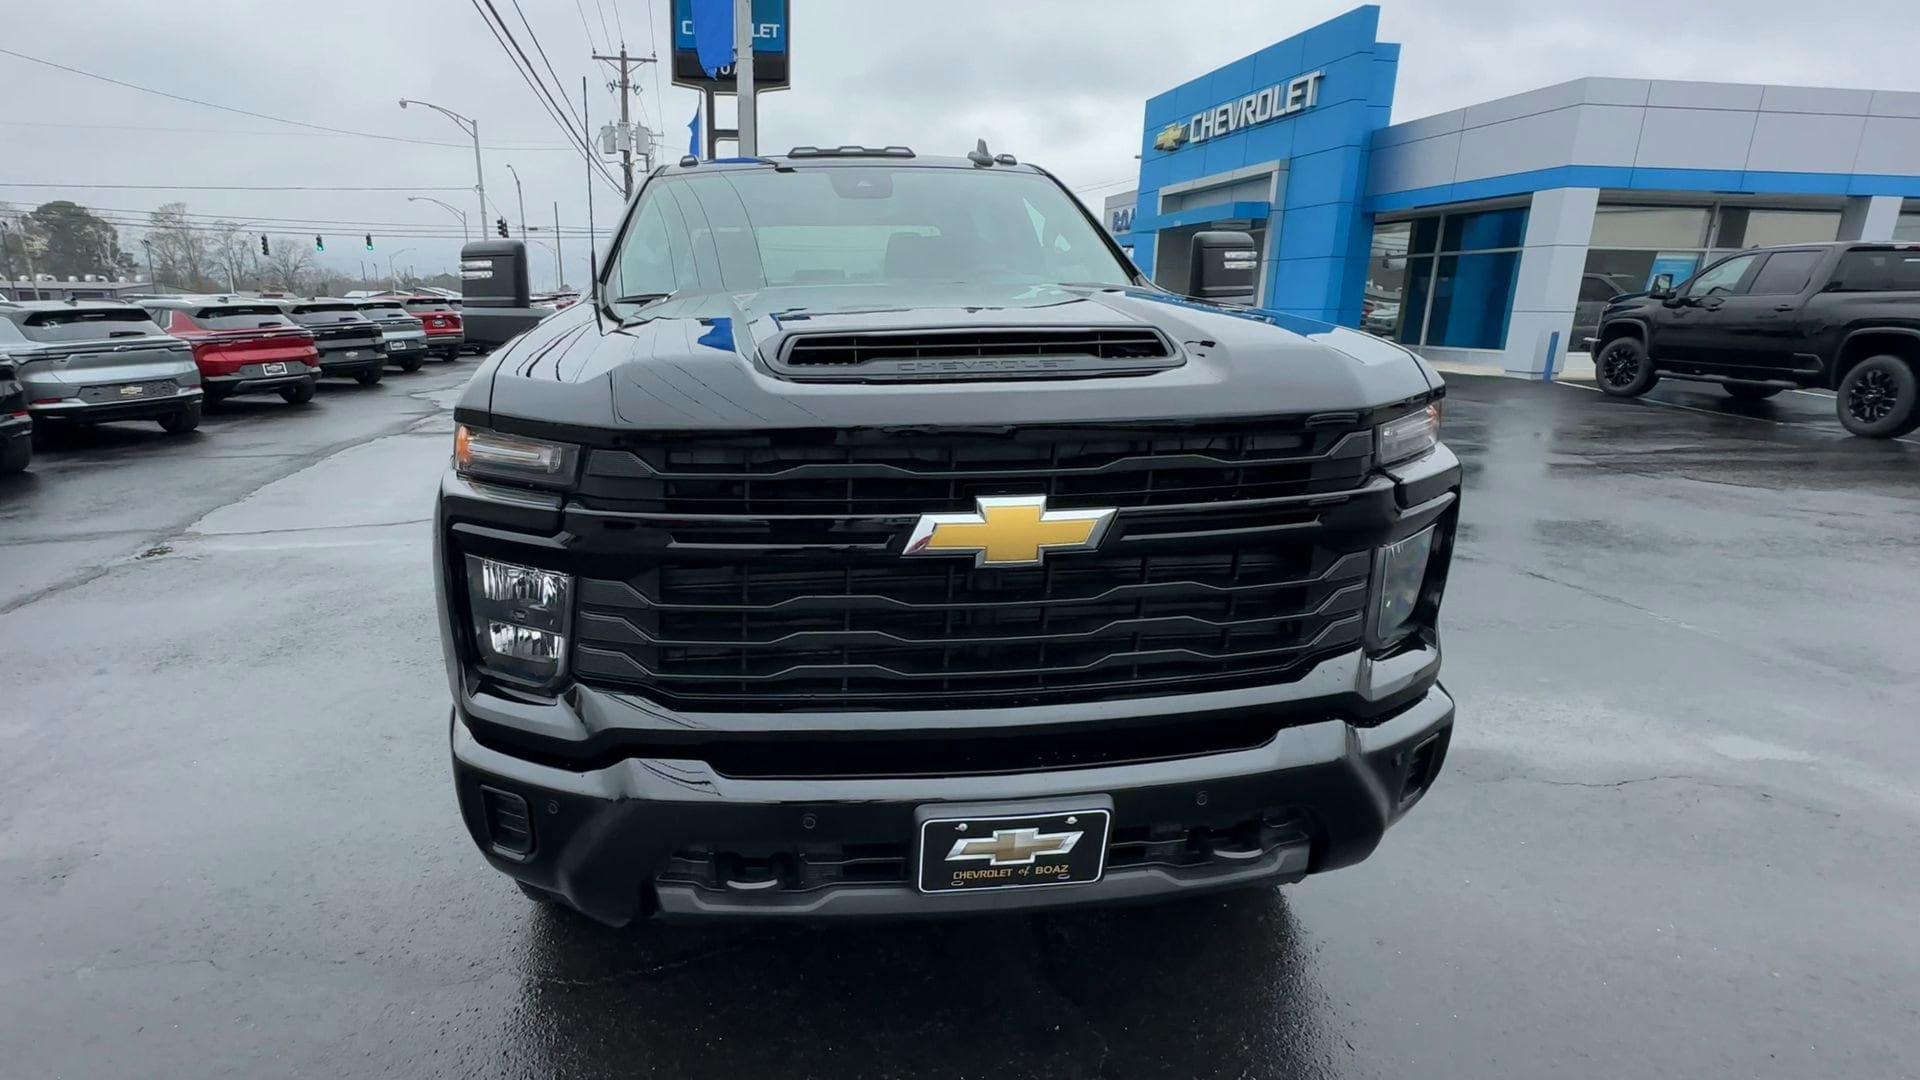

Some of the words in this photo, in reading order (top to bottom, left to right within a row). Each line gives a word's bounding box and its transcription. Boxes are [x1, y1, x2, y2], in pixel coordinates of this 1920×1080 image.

[1189, 70, 1324, 143] CHEVROLET
[897, 358, 1075, 372] CHEVROLET
[953, 868, 1013, 880] CHEVROLET
[1018, 865, 1031, 877] of
[1035, 864, 1068, 875] BOAZ
